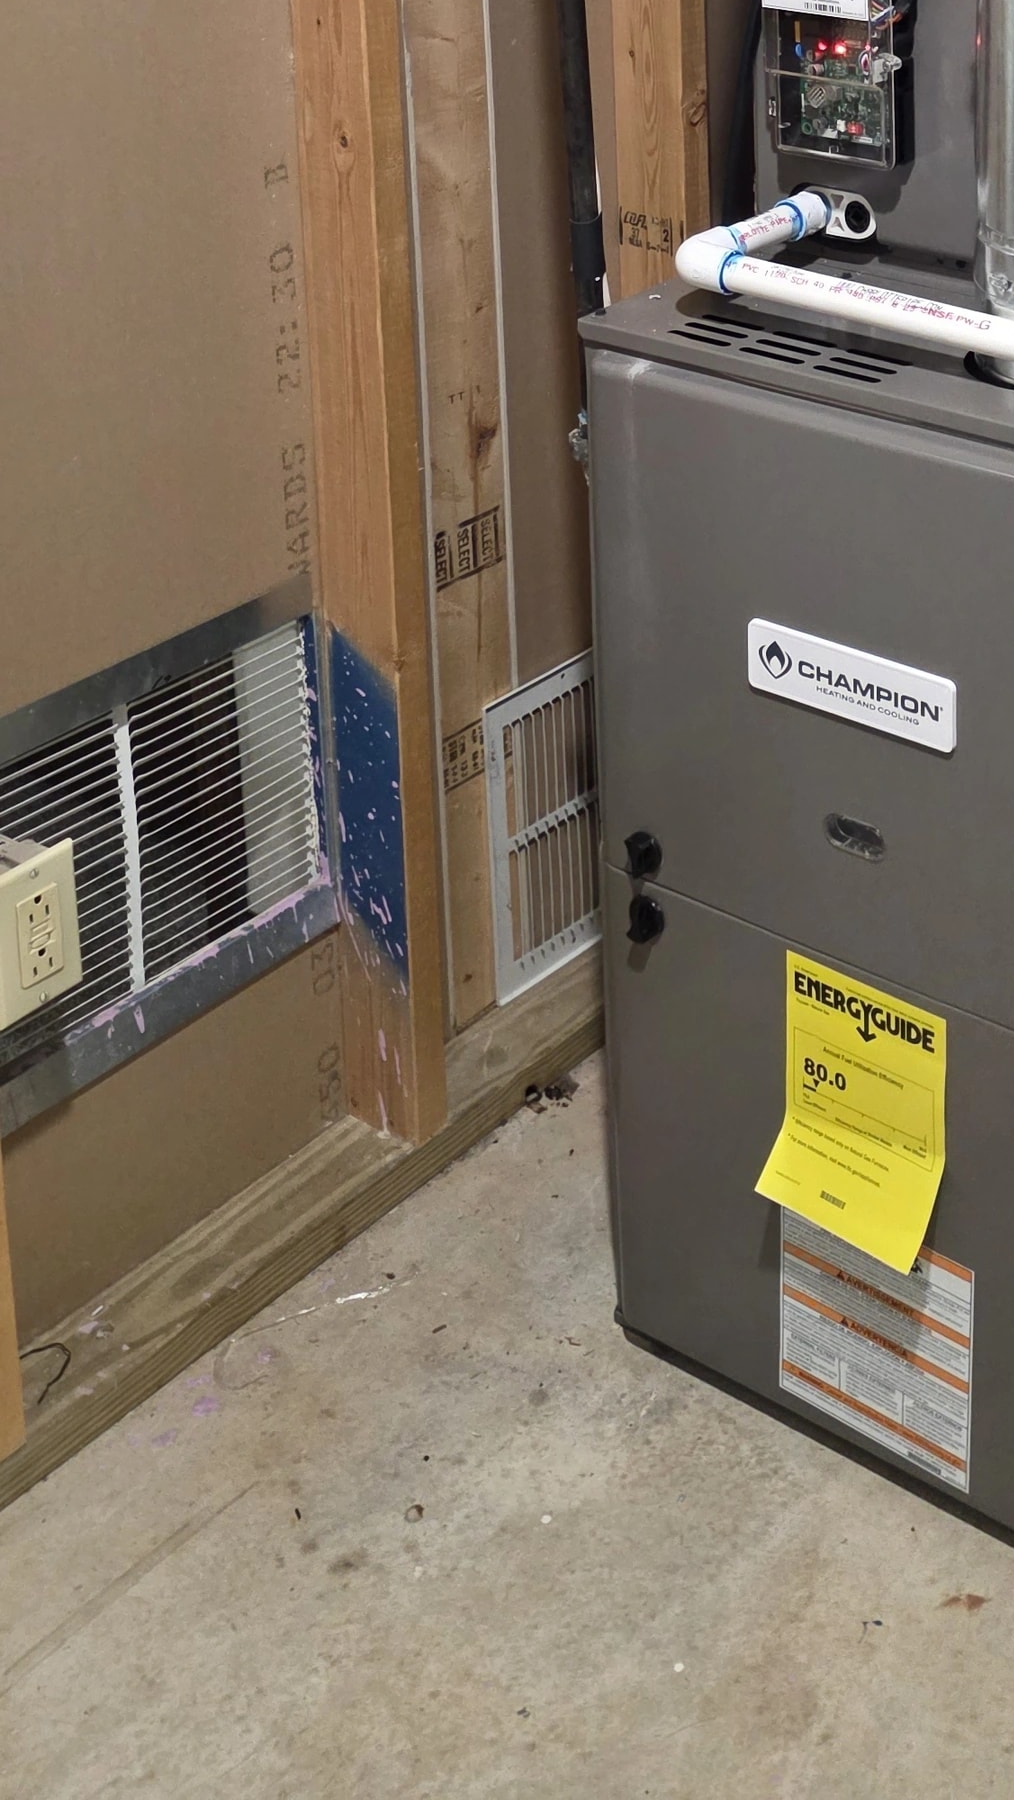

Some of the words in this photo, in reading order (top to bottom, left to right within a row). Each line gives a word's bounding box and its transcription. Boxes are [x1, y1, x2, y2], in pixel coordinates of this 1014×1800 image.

[742, 263, 759, 274] PVC
[813, 281, 825, 289] 40
[956, 312, 992, 331] PW-G
[434, 538, 448, 584] SELECT
[457, 528, 471, 573] SELECT
[480, 518, 492, 563] SELECT
[798, 660, 940, 722] CHAMPION
[816, 685, 855, 704] HEATING
[857, 700, 876, 711] AND
[877, 707, 920, 726] COOLING
[794, 970, 935, 1054] ENERGYGUIDE
[803, 1057, 847, 1091] 80.0
